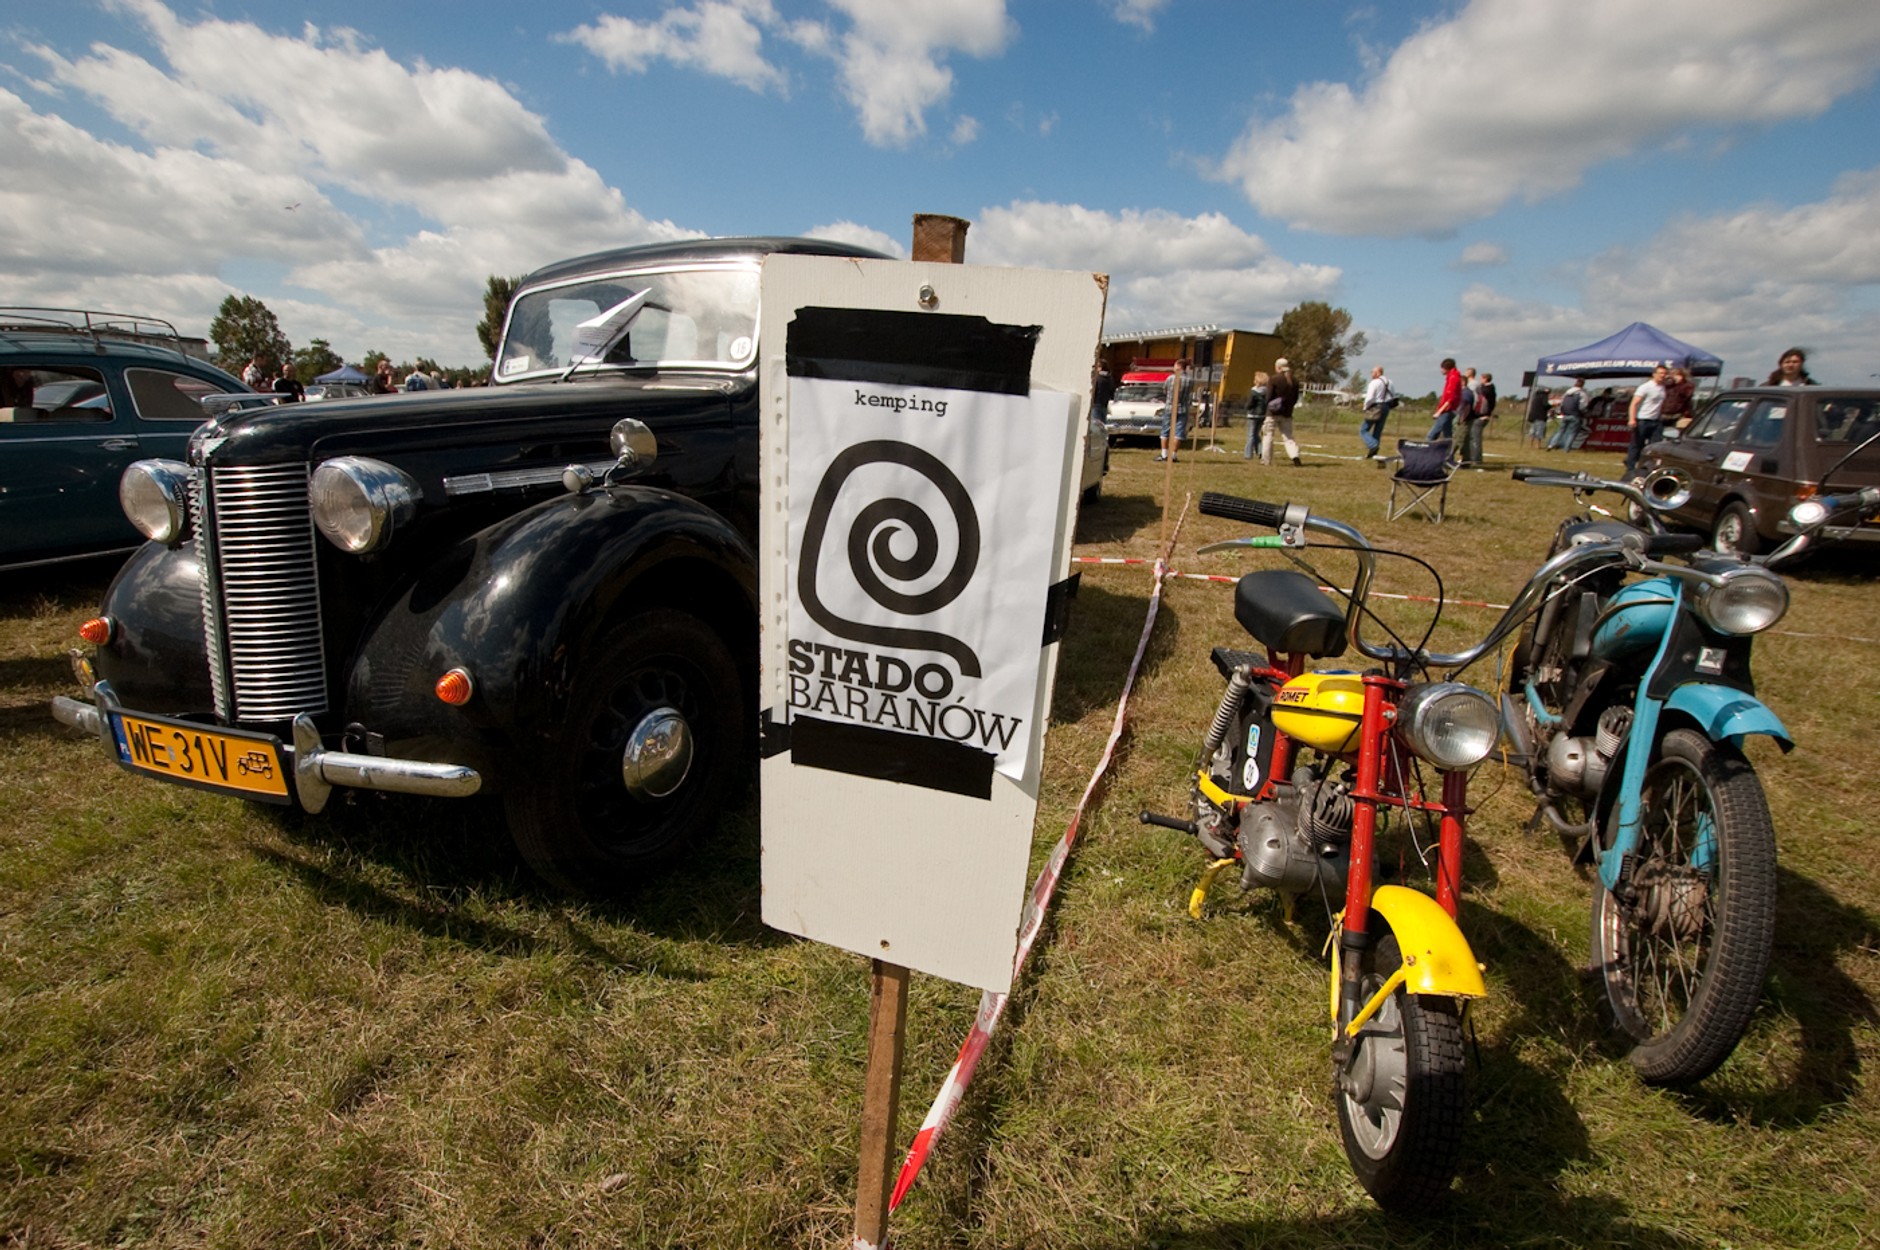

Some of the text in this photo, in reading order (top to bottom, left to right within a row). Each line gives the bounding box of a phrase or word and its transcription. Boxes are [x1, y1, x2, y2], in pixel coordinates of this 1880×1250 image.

[854, 389, 949, 418] kemping
[788, 639, 953, 700] STADO
[1280, 691, 1310, 703] ROMET
[788, 674, 1023, 751] BARANÓW
[127, 720, 229, 781] WE 31V
